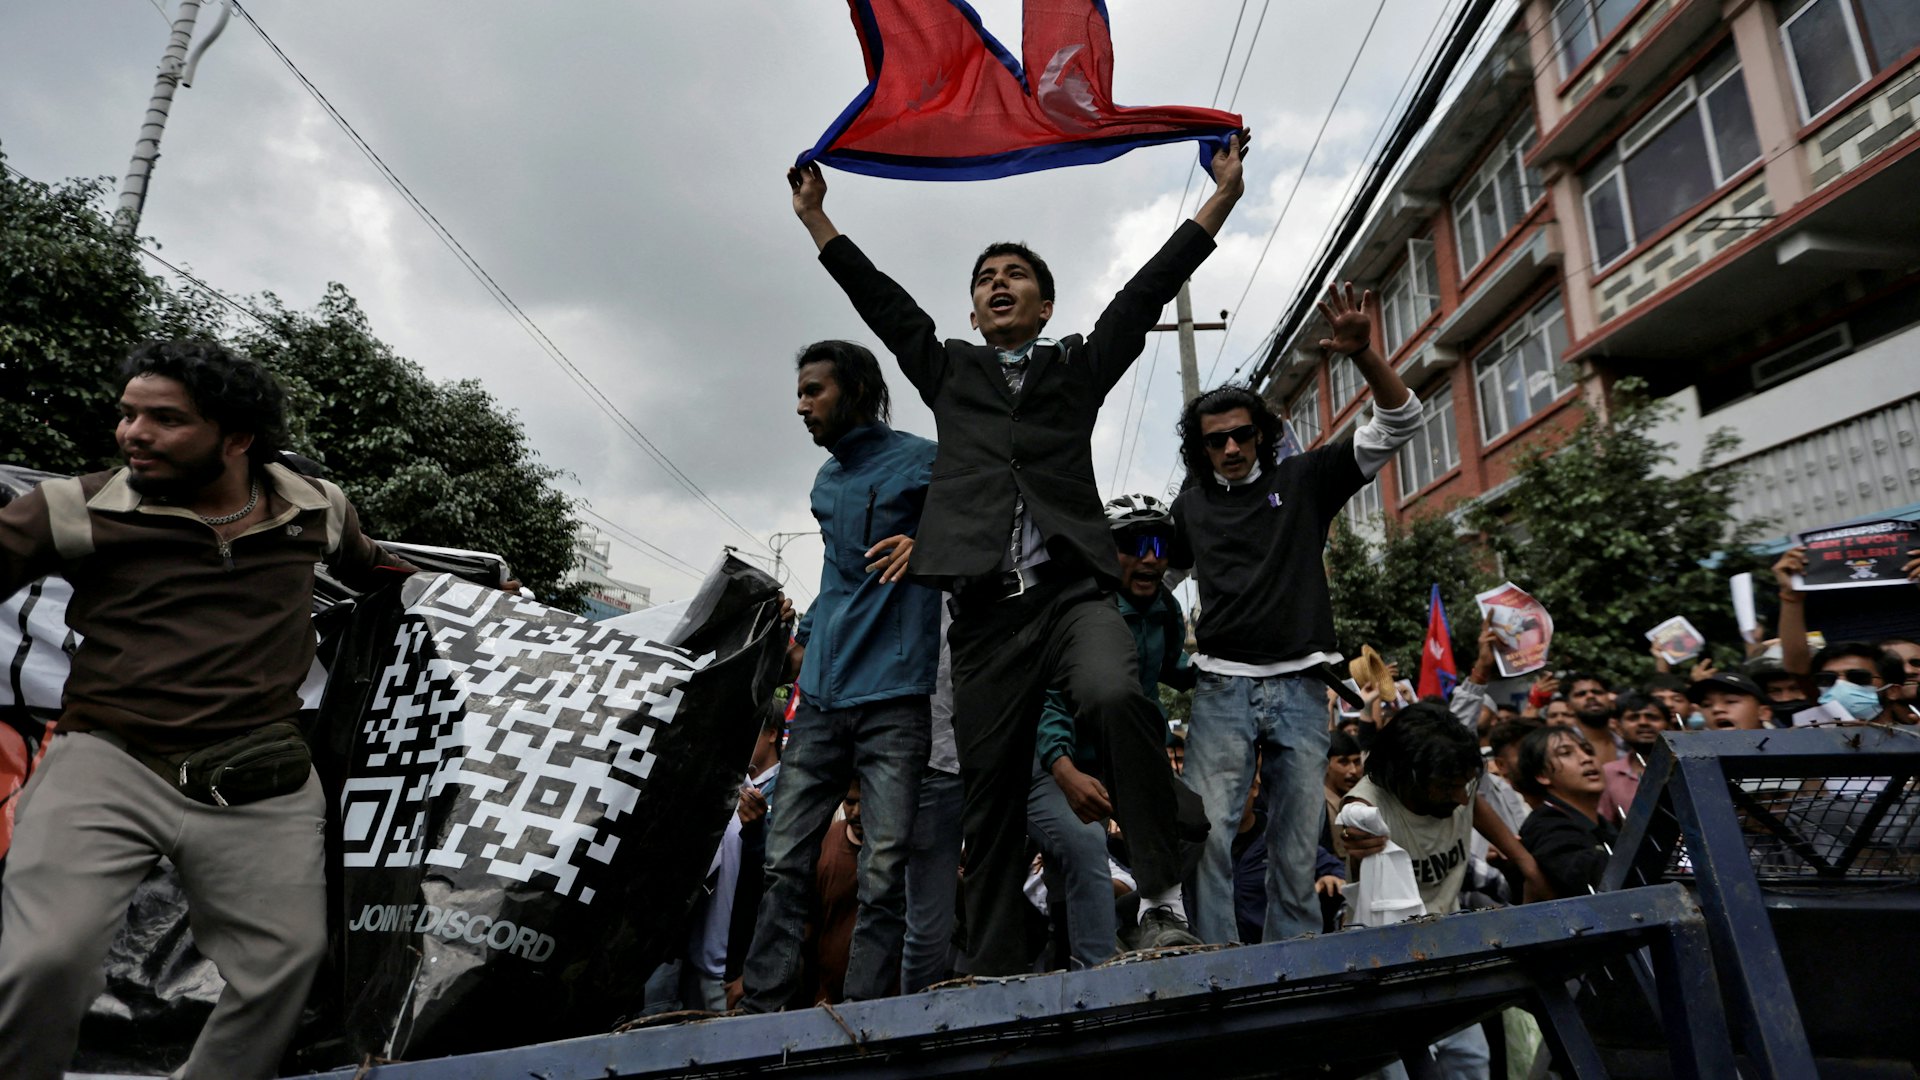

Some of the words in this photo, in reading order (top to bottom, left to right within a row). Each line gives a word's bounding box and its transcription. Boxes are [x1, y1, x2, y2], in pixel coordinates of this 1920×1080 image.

[1846, 546, 1898, 559] SILENT
[349, 904, 402, 932] JOIN
[414, 904, 556, 962] DISCORD
